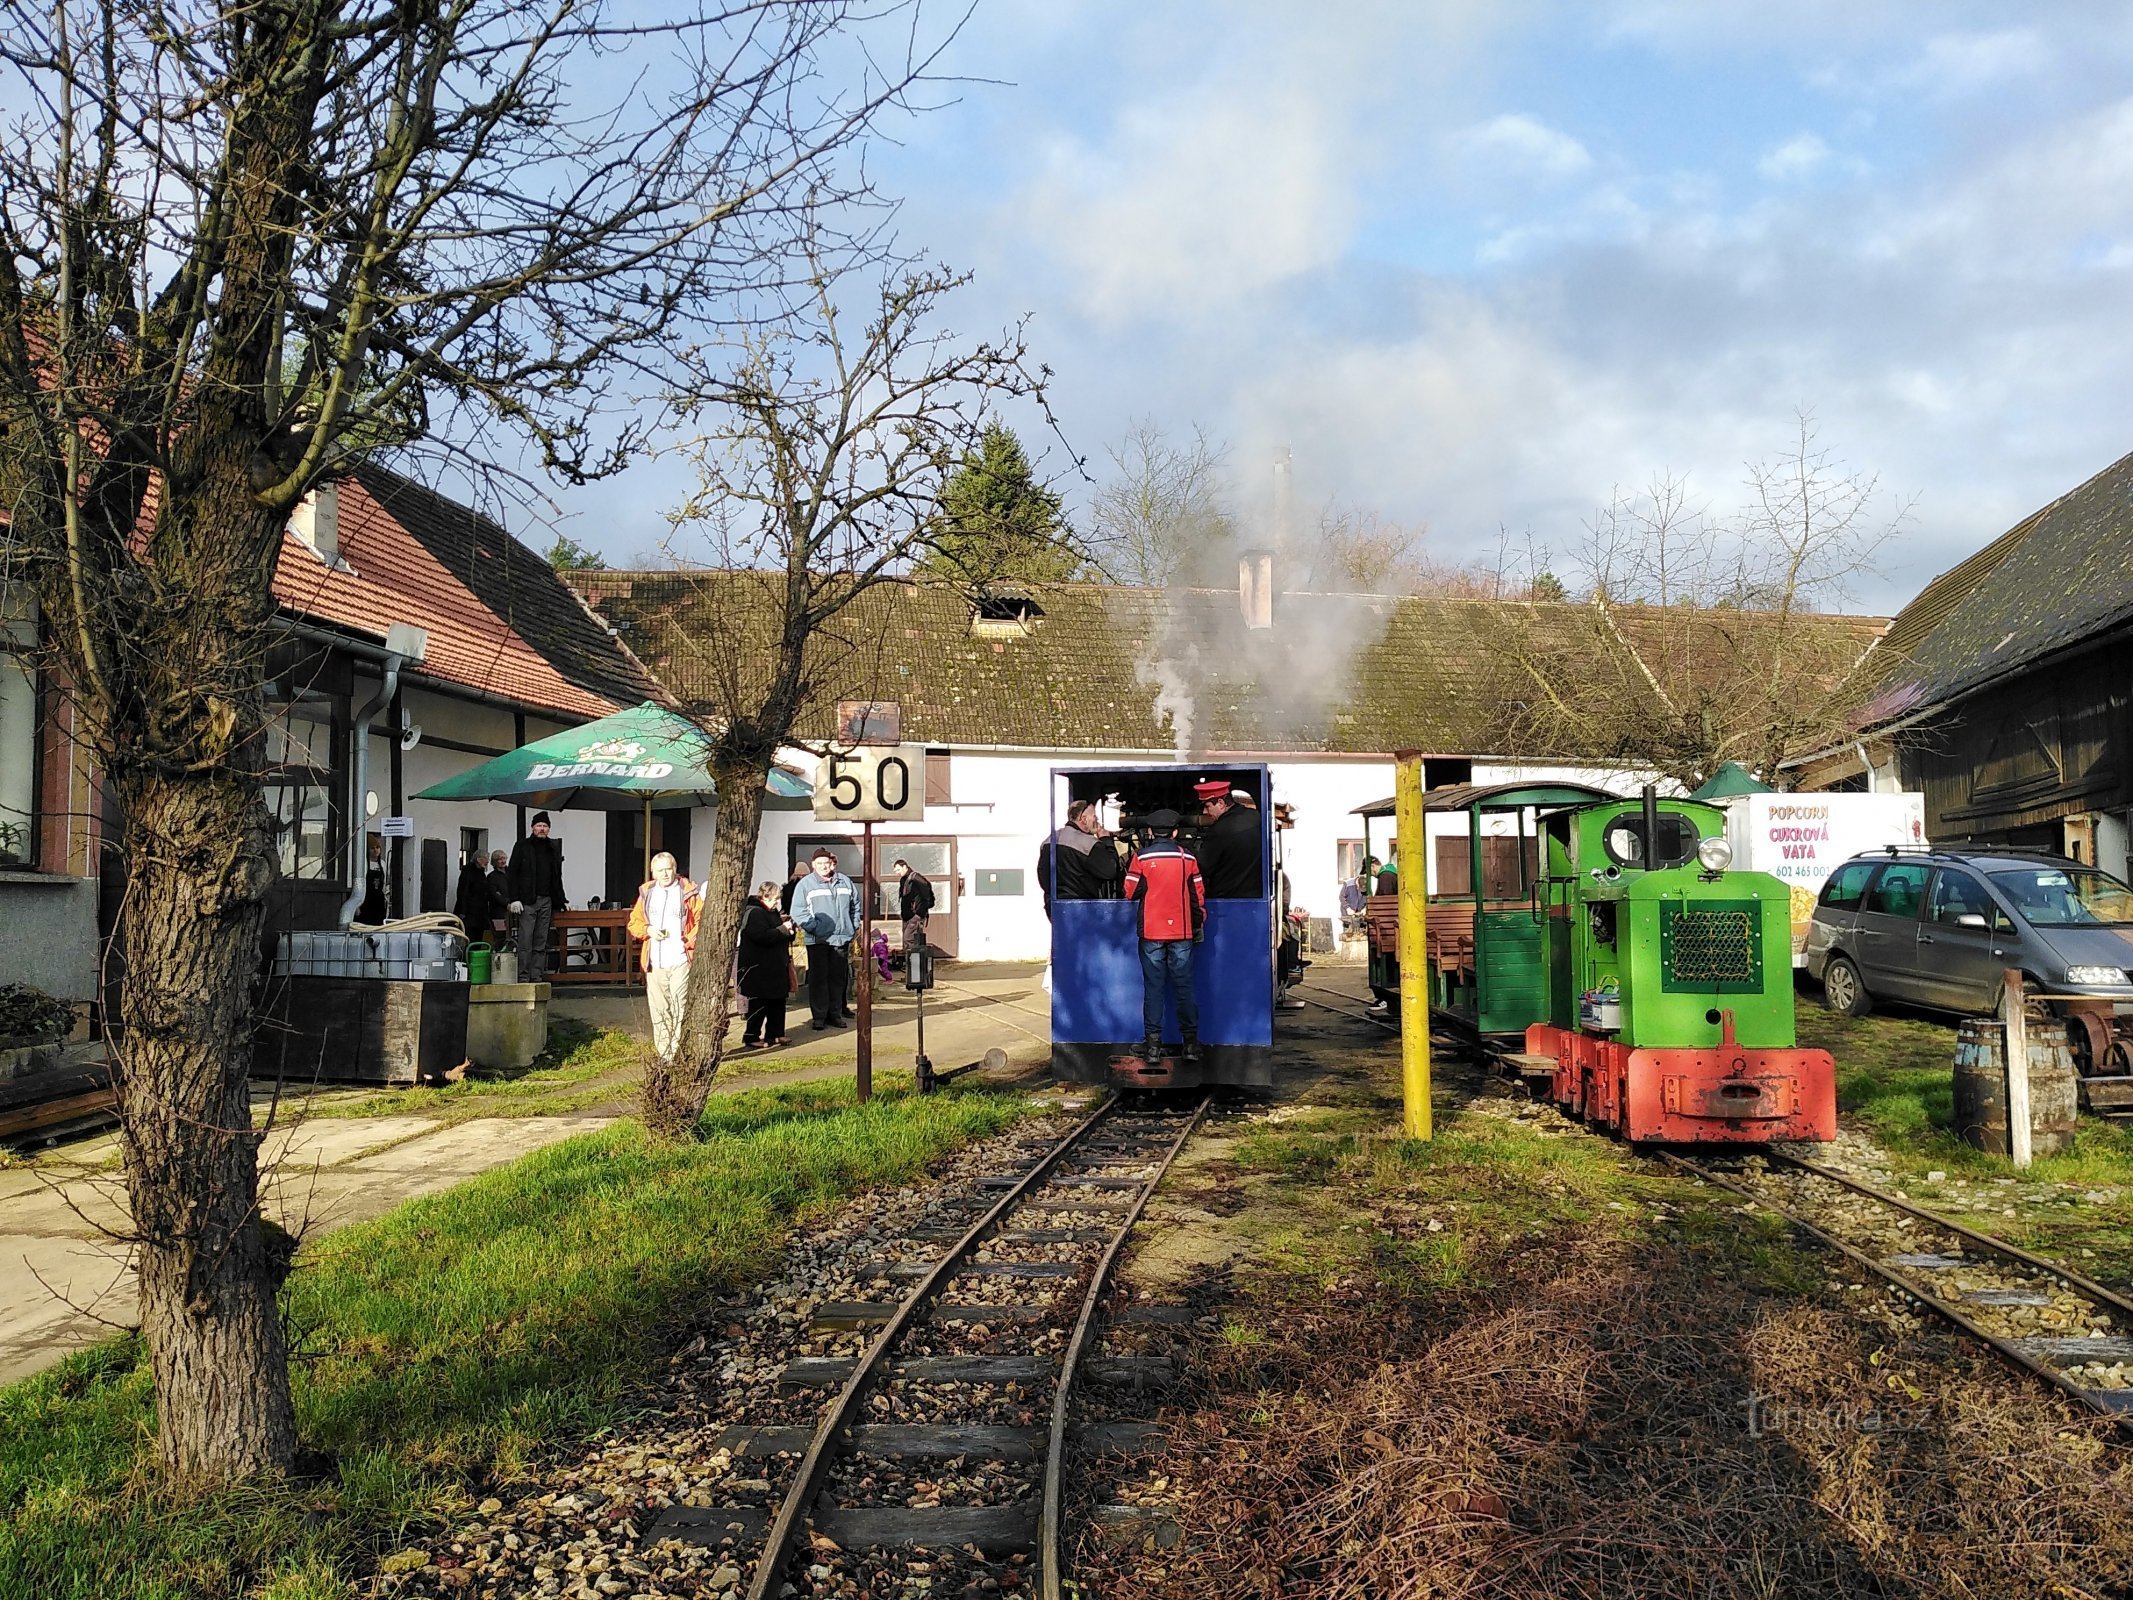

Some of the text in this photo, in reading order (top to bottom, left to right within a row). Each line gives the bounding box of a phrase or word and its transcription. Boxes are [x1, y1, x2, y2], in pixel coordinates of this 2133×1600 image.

[526, 762, 673, 780] BERNARD
[829, 756, 909, 811] 50
[1768, 805, 1829, 820] POPCORN
[1769, 822, 1829, 842] CUKROVÁ
[1782, 844, 1816, 860] VATA
[1776, 866, 1792, 877] 602
[1795, 866, 1810, 877] 465
